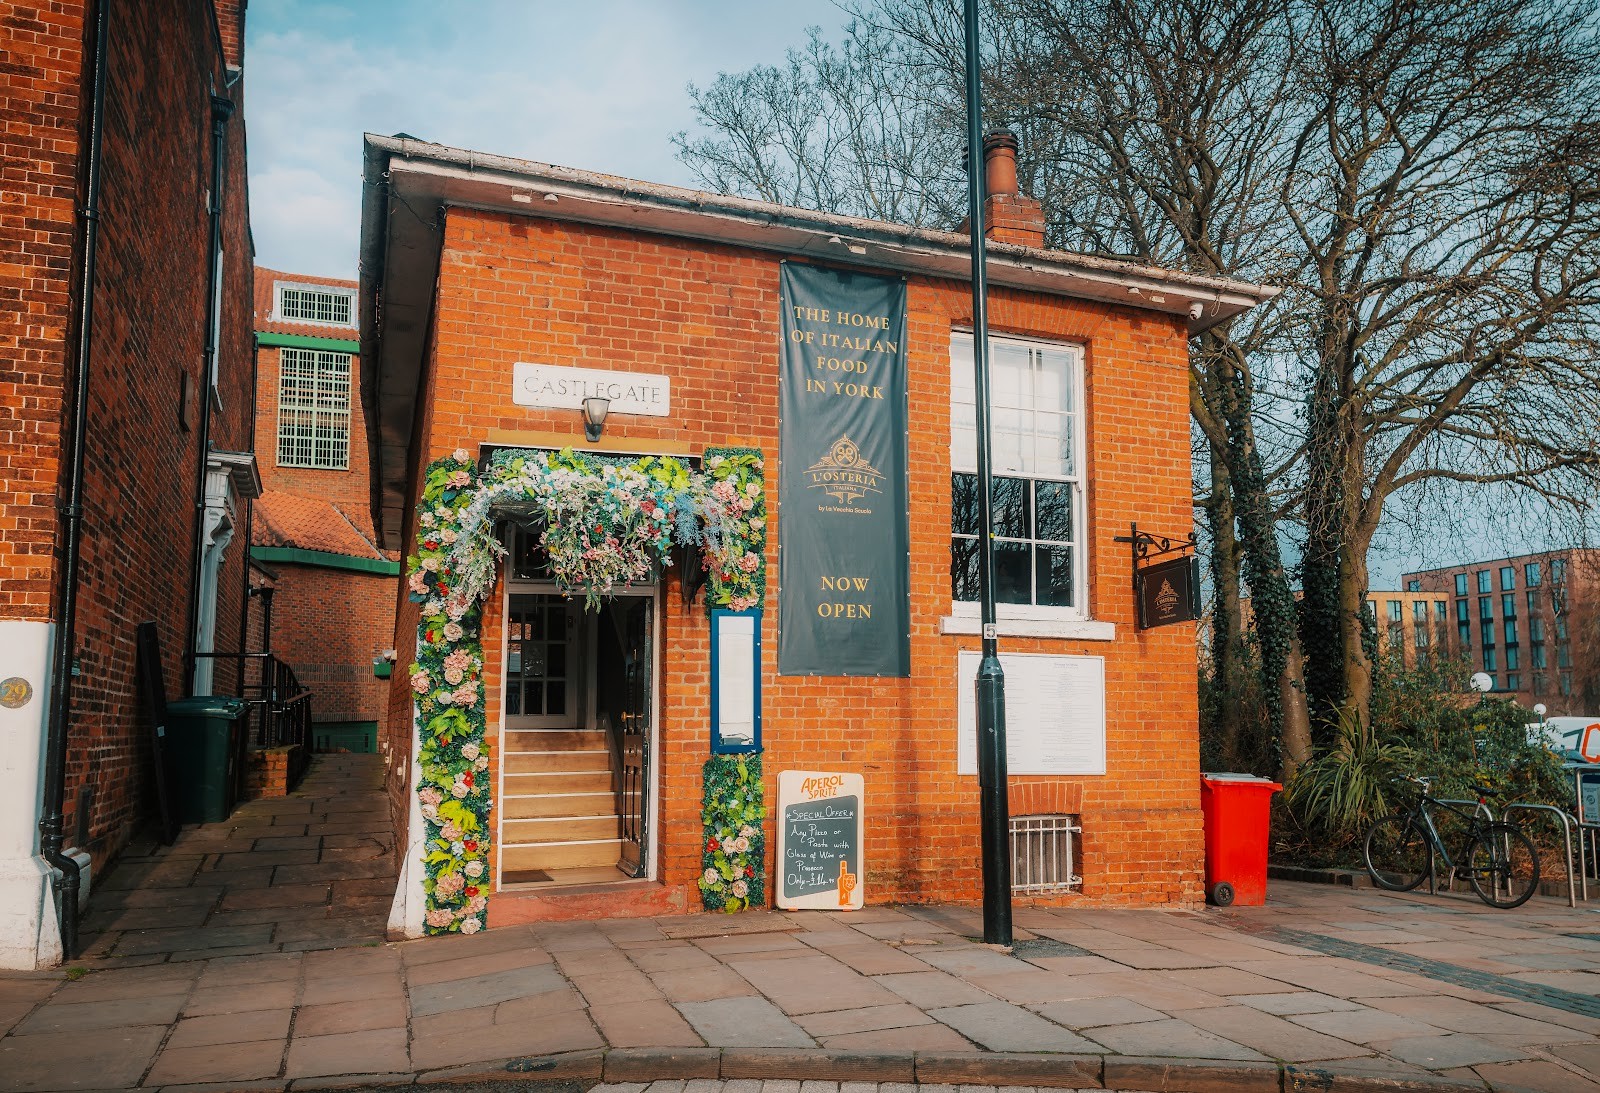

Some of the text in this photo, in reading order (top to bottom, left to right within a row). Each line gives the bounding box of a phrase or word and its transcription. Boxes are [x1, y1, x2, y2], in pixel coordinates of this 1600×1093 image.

[793, 306, 890, 330] THE HOME
[791, 330, 898, 354] OF ITALIAN
[816, 356, 868, 374] FOOD
[523, 377, 661, 404] CASTLEGATE
[806, 379, 885, 399] IN YORK
[813, 471, 877, 487] L'OSTERIA
[821, 576, 869, 592] NOW
[817, 602, 872, 619] OPEN
[986, 624, 996, 638] 5
[2, 683, 27, 702] 29
[801, 775, 844, 793] APEROL
[808, 787, 837, 800] SPRITZ
[790, 824, 807, 844] Any
[808, 823, 828, 837] Pizza
[807, 837, 850, 849] Pasta with
[786, 848, 807, 858] Glass
[809, 851, 817, 863] of
[795, 859, 824, 872] Prosecco
